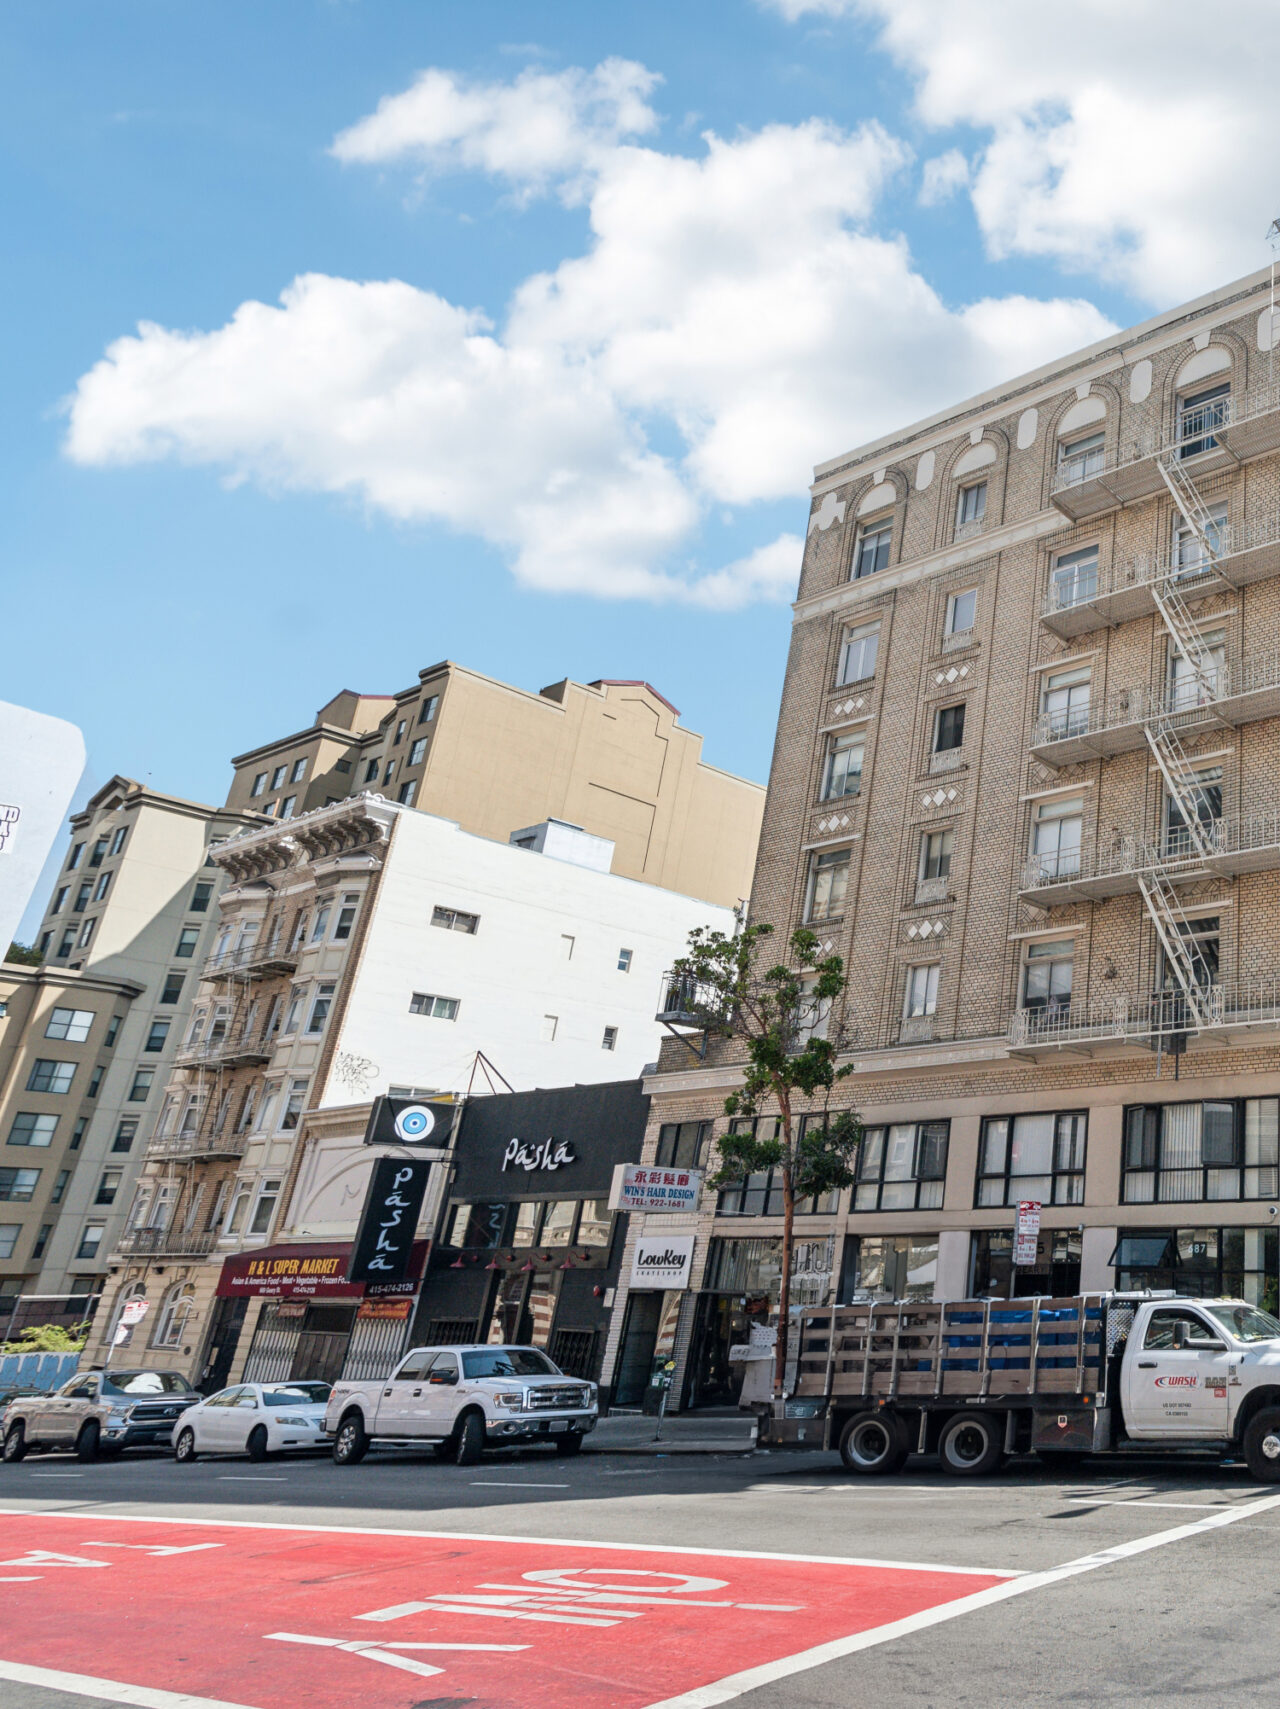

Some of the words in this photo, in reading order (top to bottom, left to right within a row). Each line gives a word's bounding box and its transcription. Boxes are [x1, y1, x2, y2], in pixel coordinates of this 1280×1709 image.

[624, 1185, 646, 1198] WIN'S
[647, 1187, 667, 1199] HAIR
[668, 1188, 696, 1201] DESIGN
[631, 1197, 647, 1206] TEL:
[1188, 1243, 1206, 1254] 687
[248, 1261, 256, 1275] H
[256, 1260, 265, 1275] &
[266, 1260, 271, 1274] L
[271, 1259, 299, 1275] SUPER
[300, 1258, 340, 1274] MARKET
[267, 1277, 281, 1285] Food
[321, 1275, 337, 1284] Frozen
